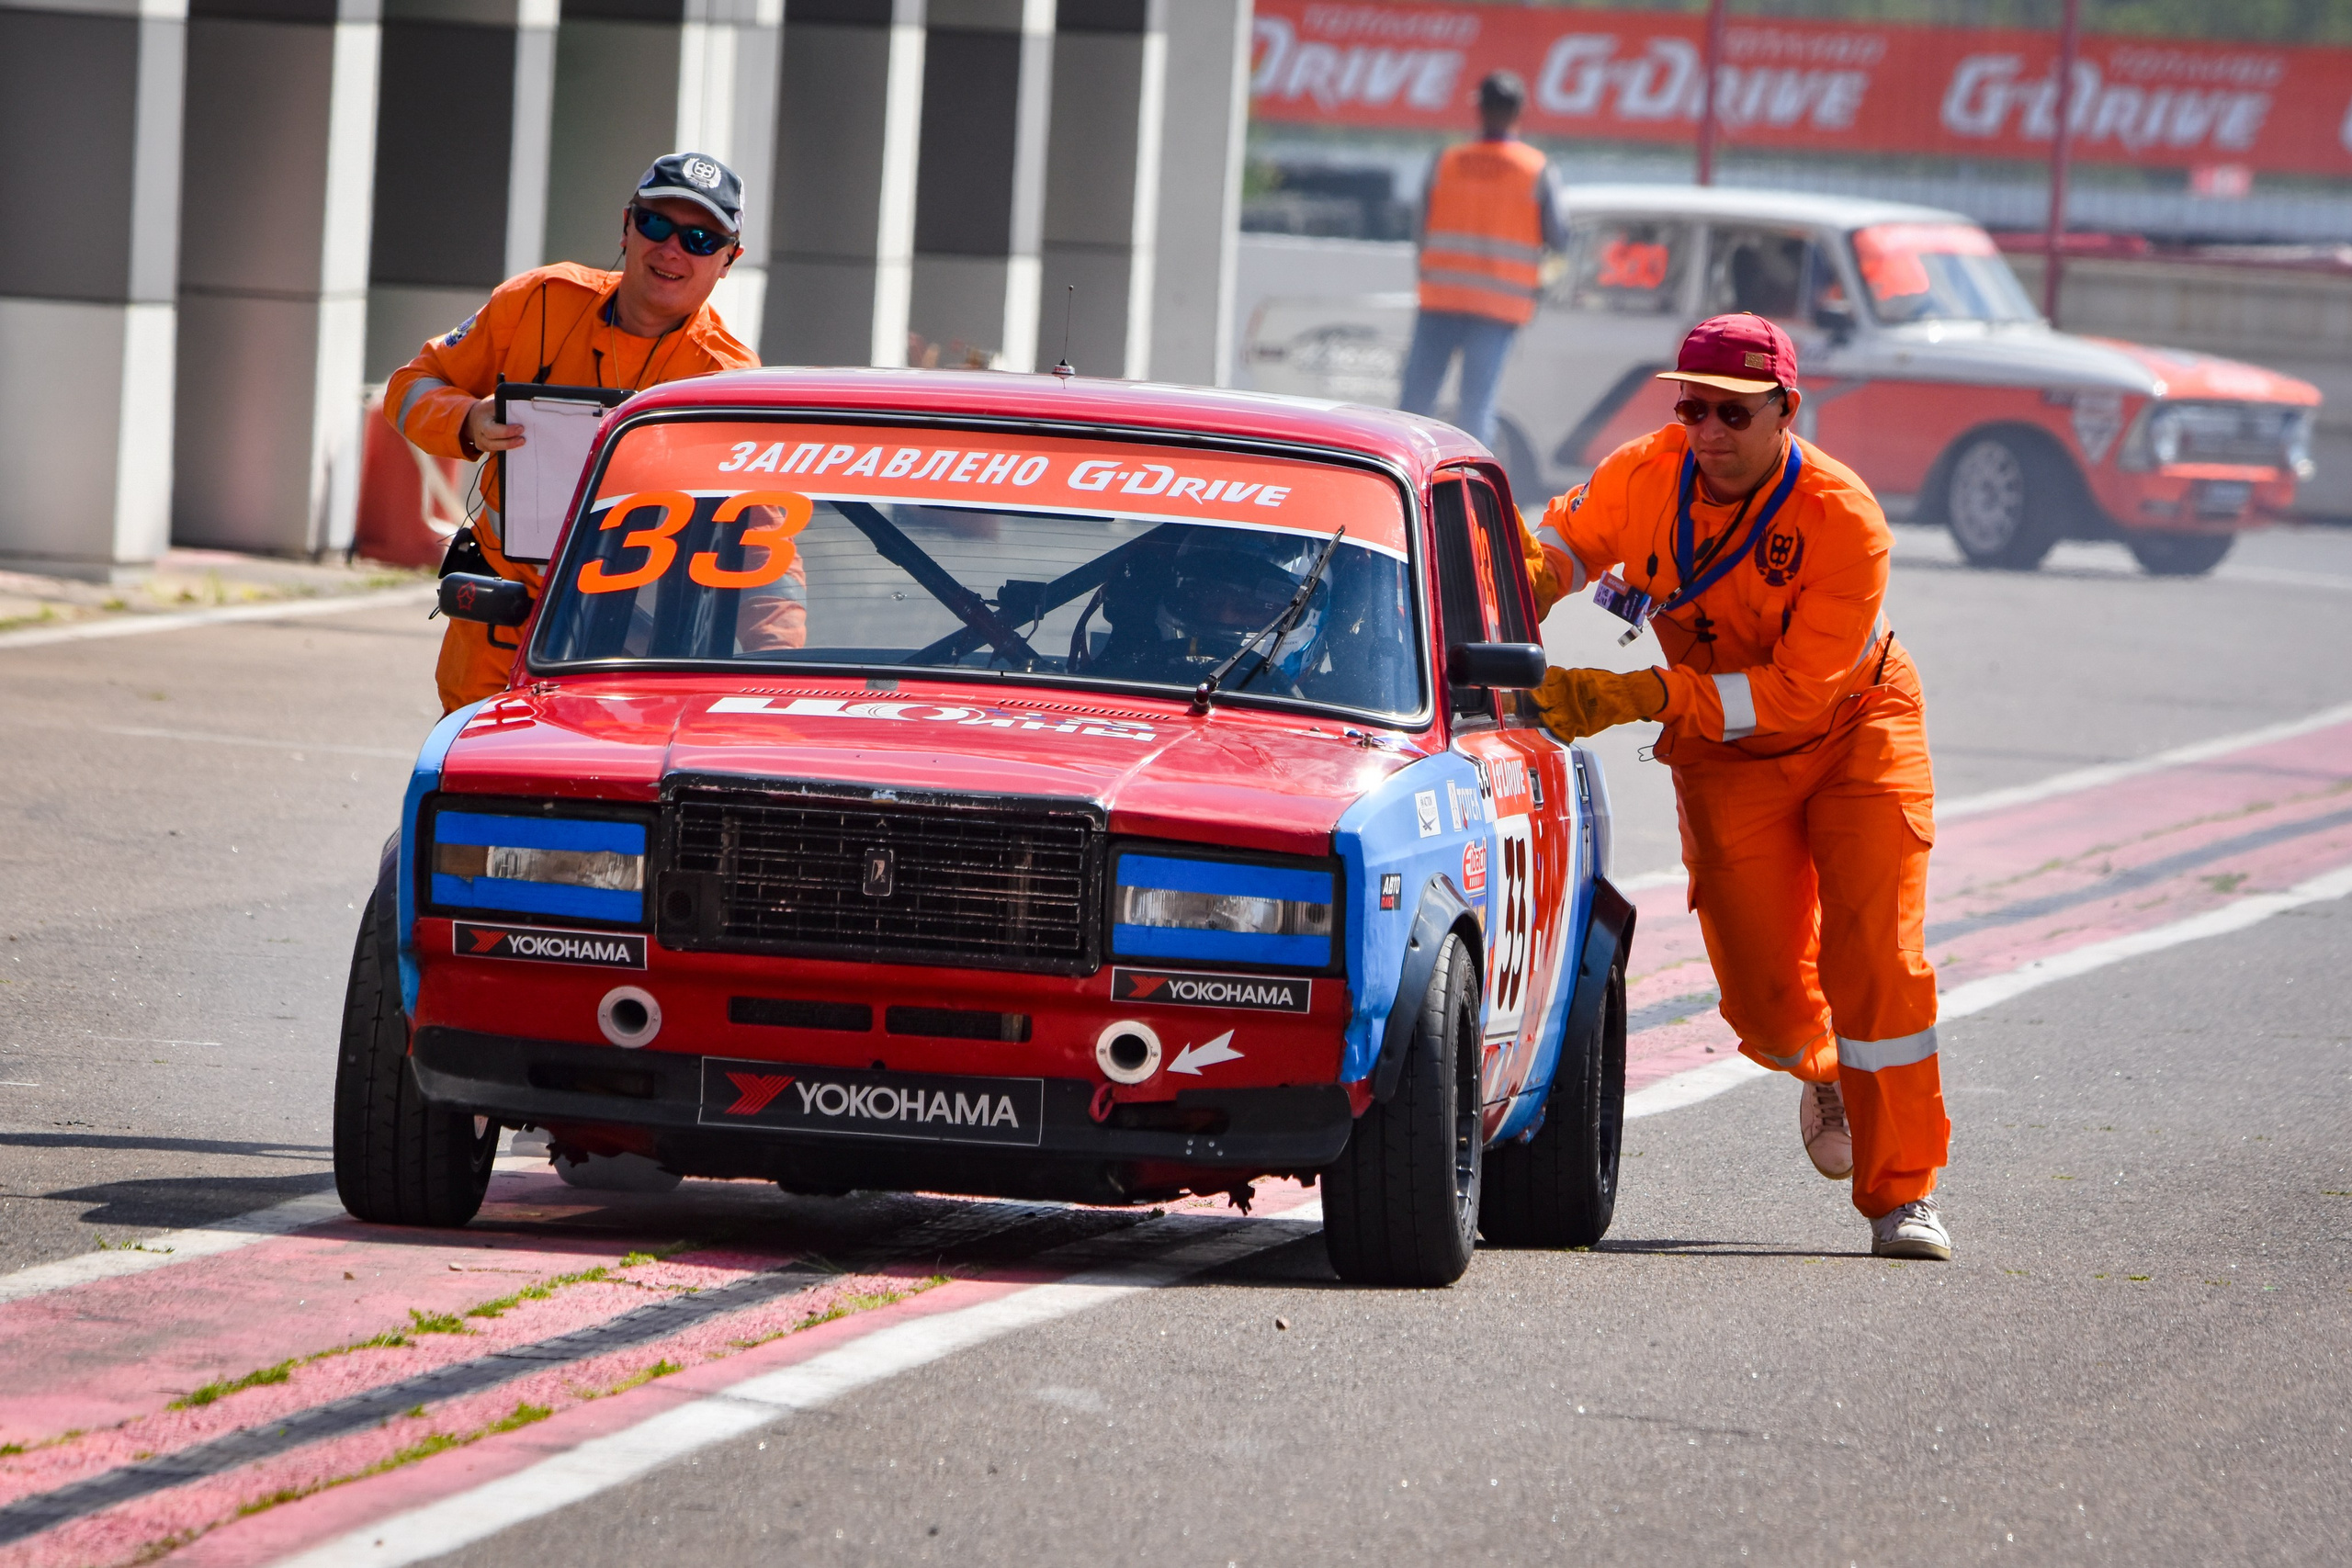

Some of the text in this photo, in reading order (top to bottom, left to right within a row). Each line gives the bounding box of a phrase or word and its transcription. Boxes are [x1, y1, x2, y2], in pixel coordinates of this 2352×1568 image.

[718, 441, 1049, 487] ЗАПРАВЛЕНО
[577, 490, 813, 593] 33
[507, 933, 630, 963] YOKOHAMA
[1168, 980, 1295, 1006] YOKOHAMA
[796, 1081, 1019, 1129] YOKOHAMA
